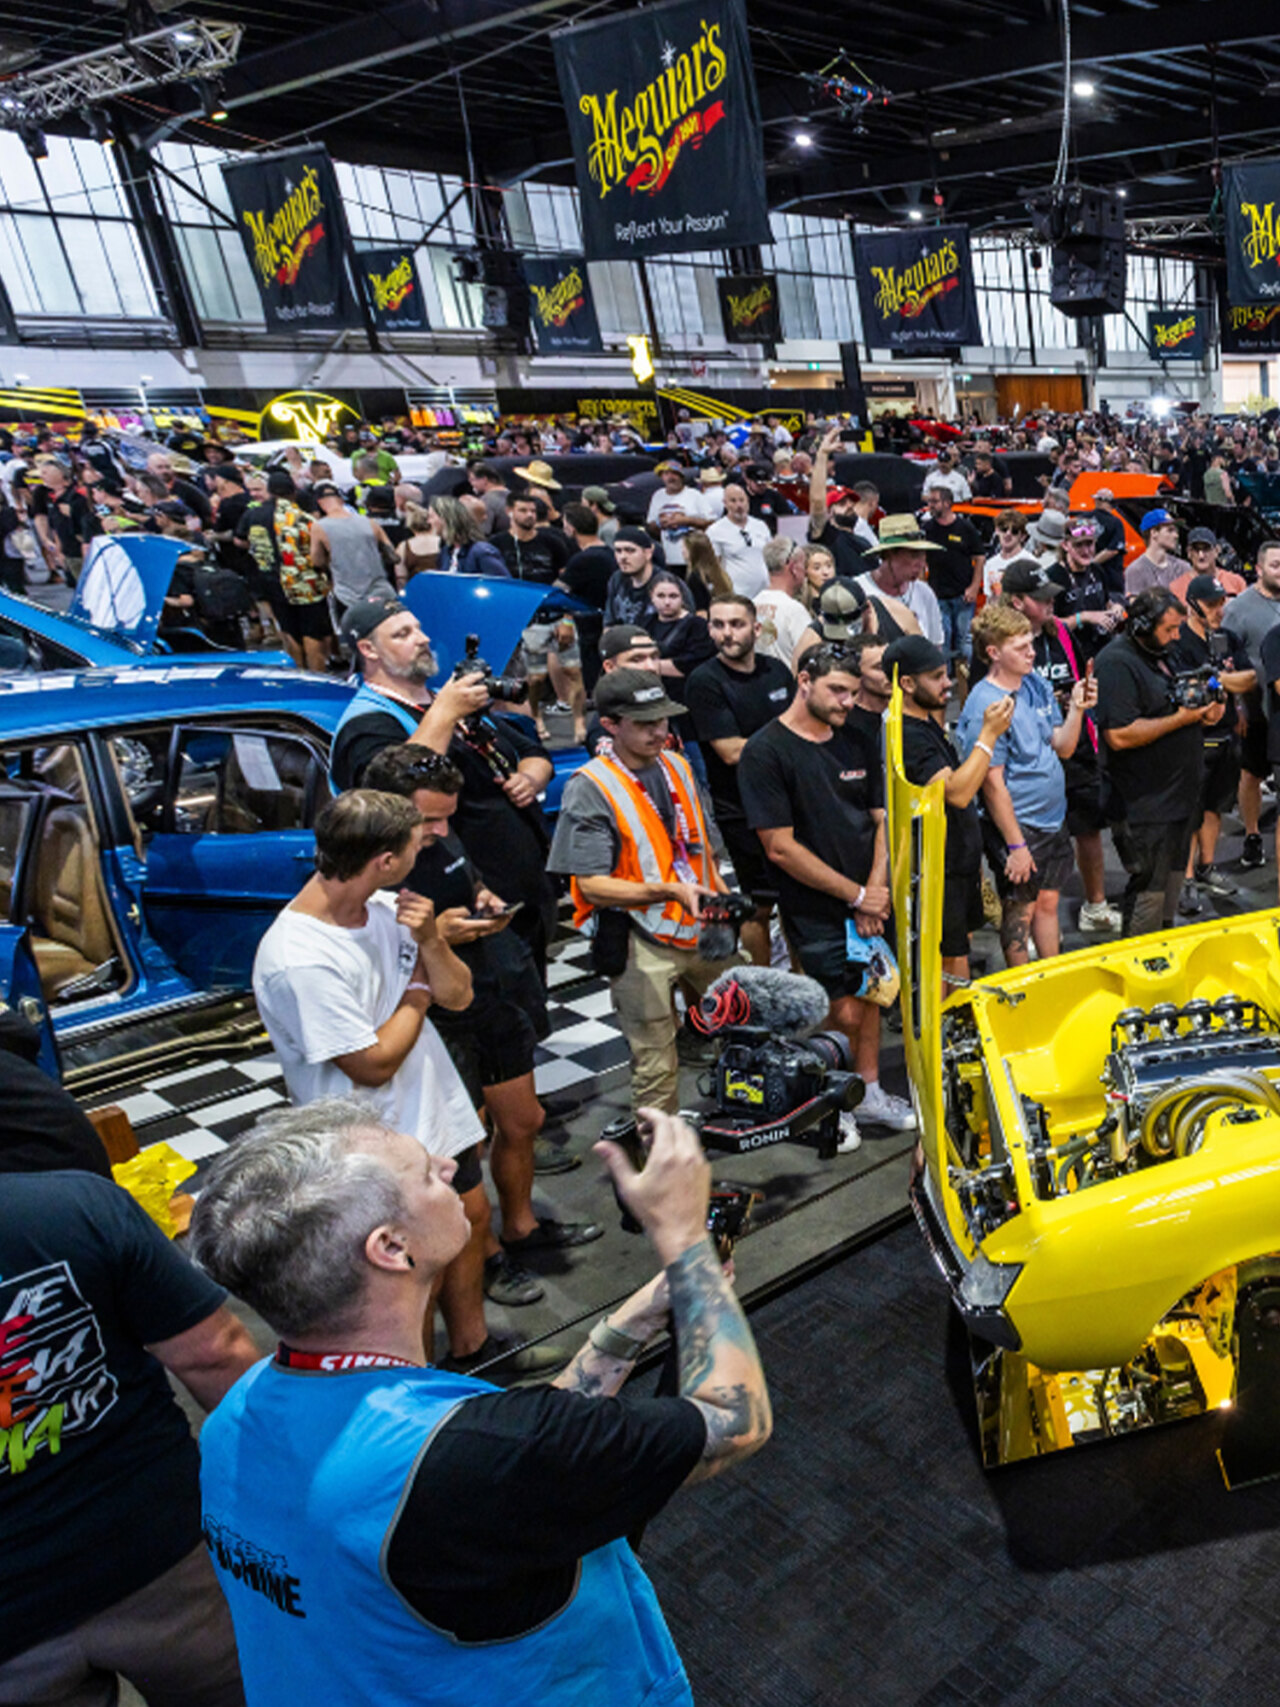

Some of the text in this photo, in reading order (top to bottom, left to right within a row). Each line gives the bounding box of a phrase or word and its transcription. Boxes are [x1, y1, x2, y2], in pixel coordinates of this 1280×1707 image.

[579, 19, 726, 199] Meguiar's
[658, 216, 683, 235] Your
[870, 238, 960, 319] Meguiar's
[740, 1126, 790, 1151] RONIN
